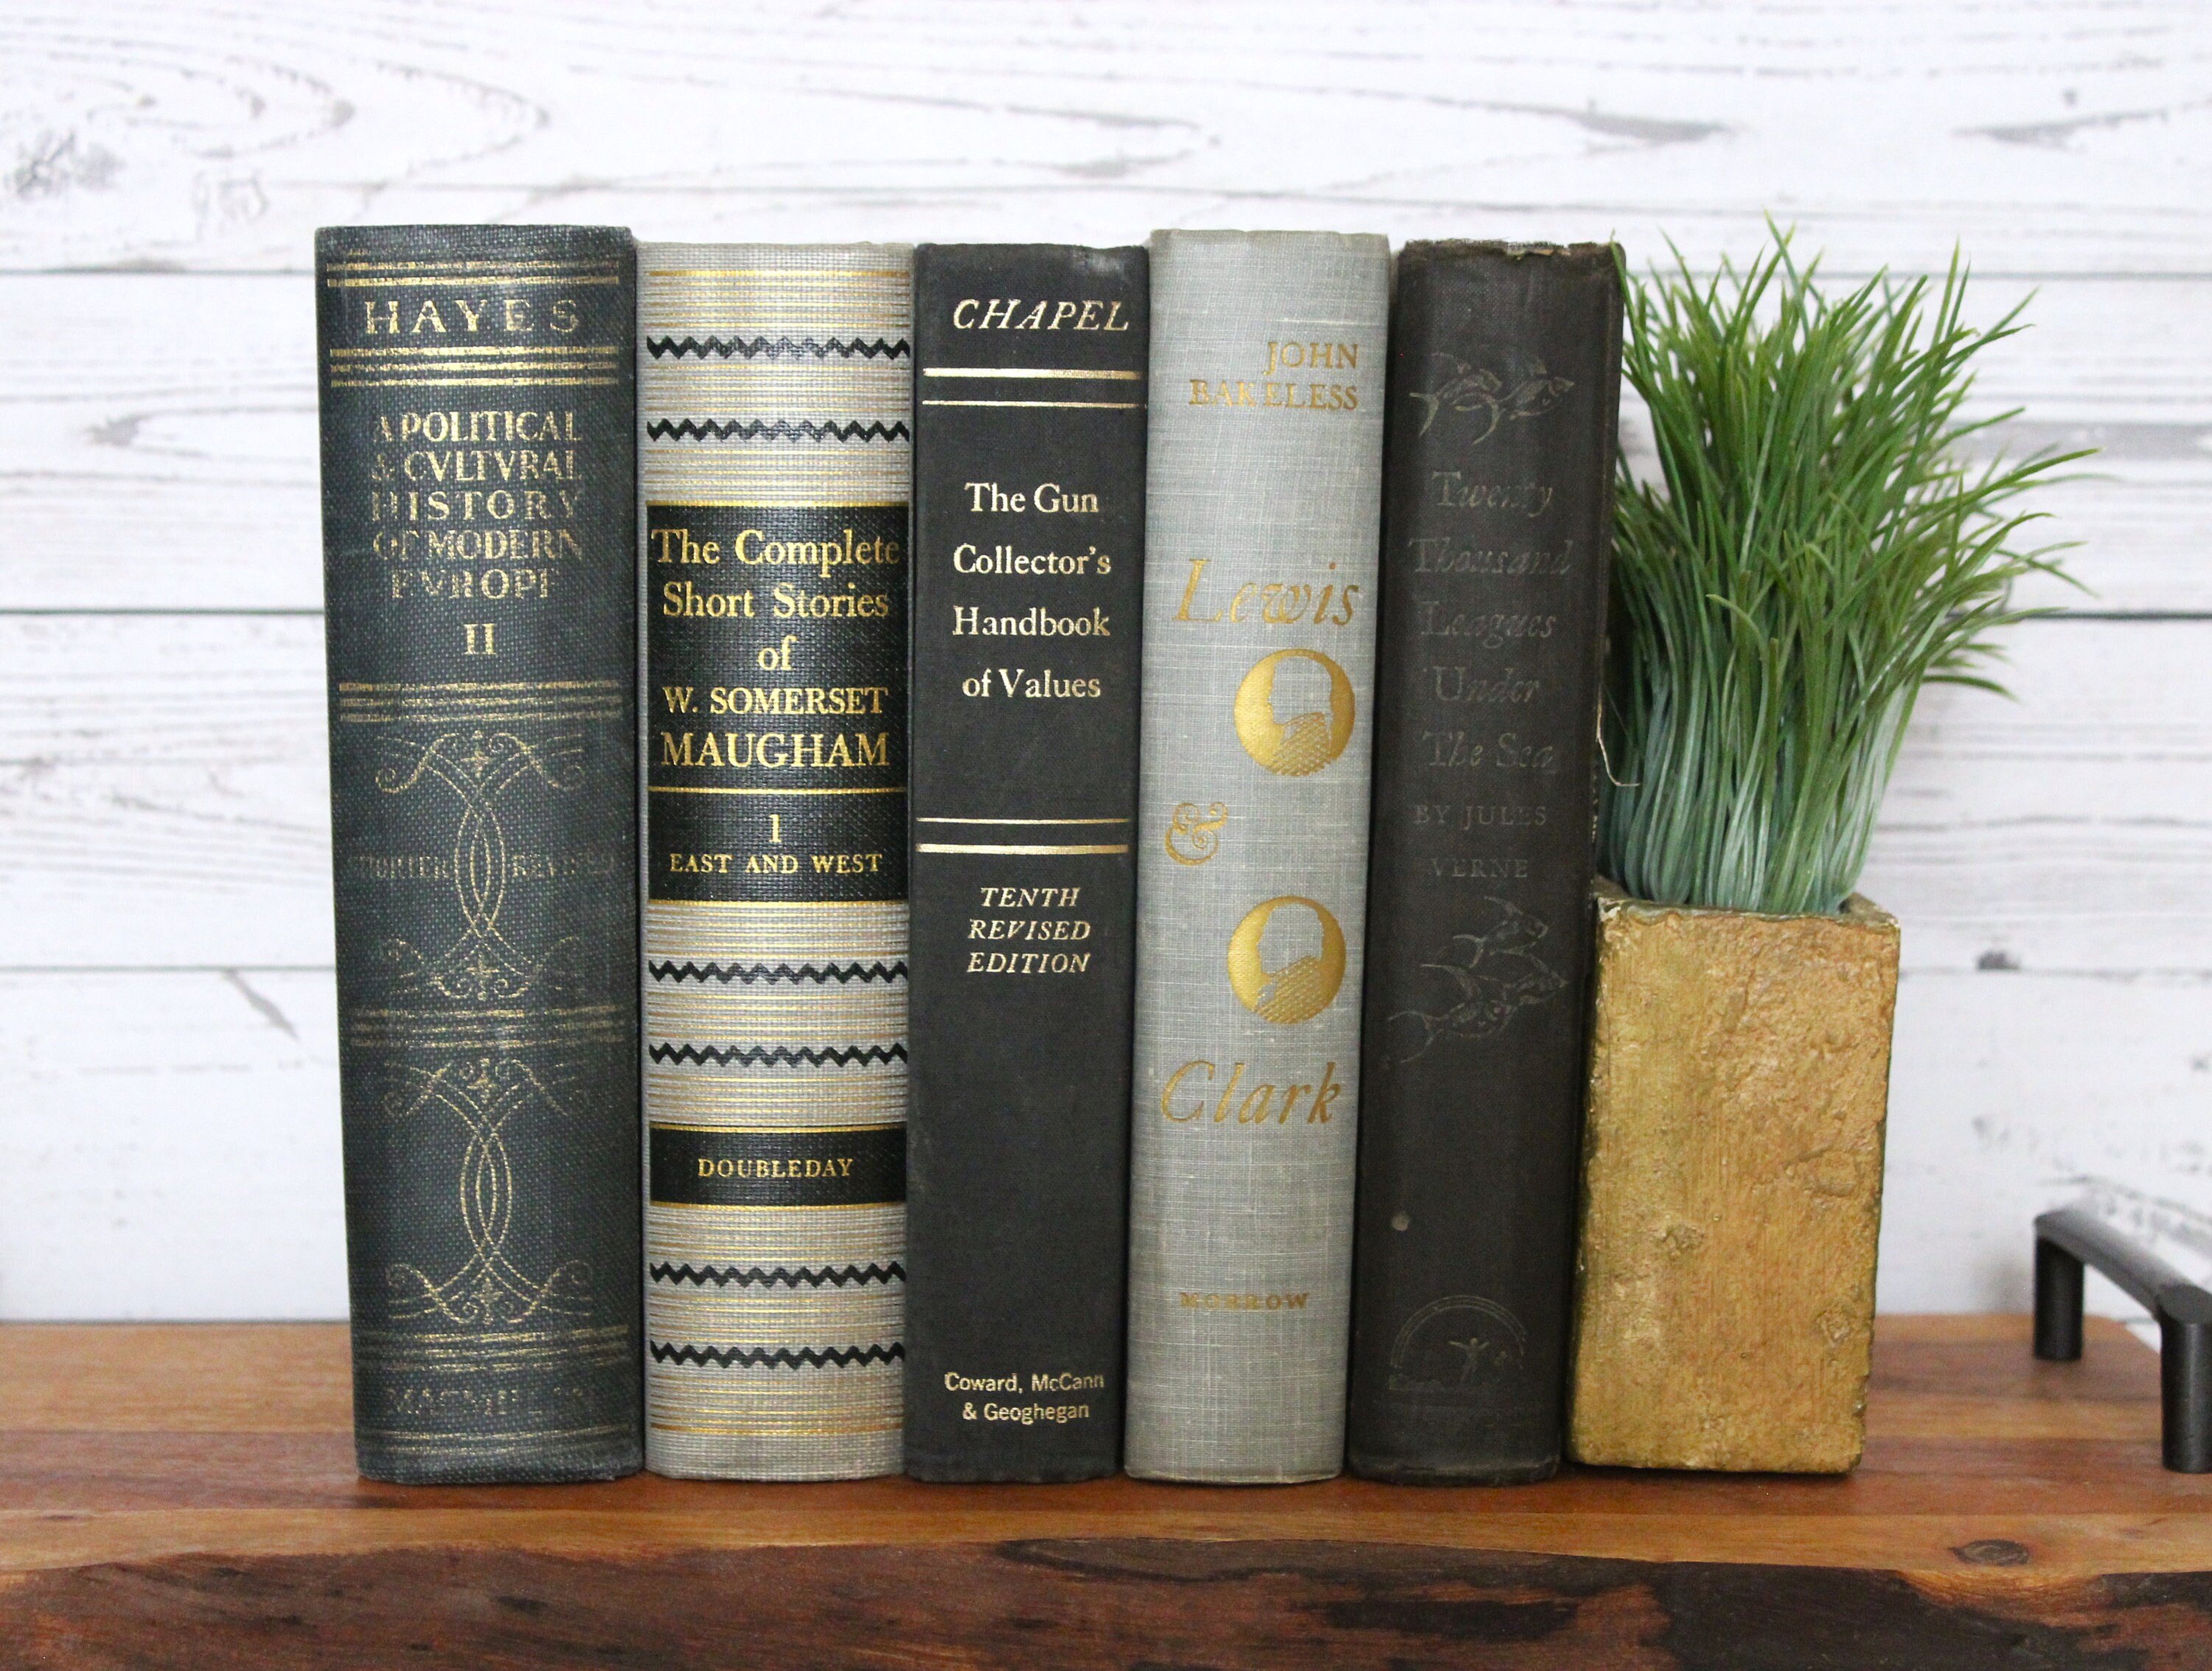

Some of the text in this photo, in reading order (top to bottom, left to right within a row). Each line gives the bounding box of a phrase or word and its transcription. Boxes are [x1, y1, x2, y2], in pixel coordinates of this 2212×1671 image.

[364, 299, 580, 334] HAYES
[952, 298, 1130, 332] CHAPEL
[1262, 341, 1358, 375] JOHN
[1189, 379, 1359, 411] BAKELESS
[372, 410, 582, 442] A POLITICAL
[372, 490, 581, 521] HISTORY
[964, 482, 1099, 514] The Gun
[428, 528, 582, 560] MODERN
[651, 527, 900, 578] The Complete
[953, 542, 1111, 576] Collector's
[1408, 537, 1573, 575] Thousand
[663, 580, 889, 618] Short Stories
[1173, 557, 1360, 627] Lewis
[952, 605, 1110, 637] Handbook
[1416, 600, 1557, 649] Leagues
[464, 623, 497, 656] II
[757, 635, 798, 671] of
[961, 668, 1102, 698] of Values
[1433, 666, 1540, 702] Under
[662, 687, 889, 715] W. SOMERSET
[661, 732, 890, 768] MAUGHAM
[1422, 731, 1554, 768] The Sea
[1413, 804, 1547, 831] BY JULES
[1164, 802, 1228, 866] &
[669, 852, 883, 875] EAST AND WEST
[1430, 858, 1528, 878] VERNE
[980, 886, 1081, 907] TENTH
[967, 918, 1091, 941] REVISED
[966, 951, 1092, 973] EDITION
[1161, 1060, 1342, 1125] Clark
[698, 1158, 854, 1178] DOUBLEDAY
[1179, 1292, 1310, 1311] MORROW
[944, 1371, 1105, 1394] Coward, McCann
[961, 1402, 1091, 1425] & Geoghegan
